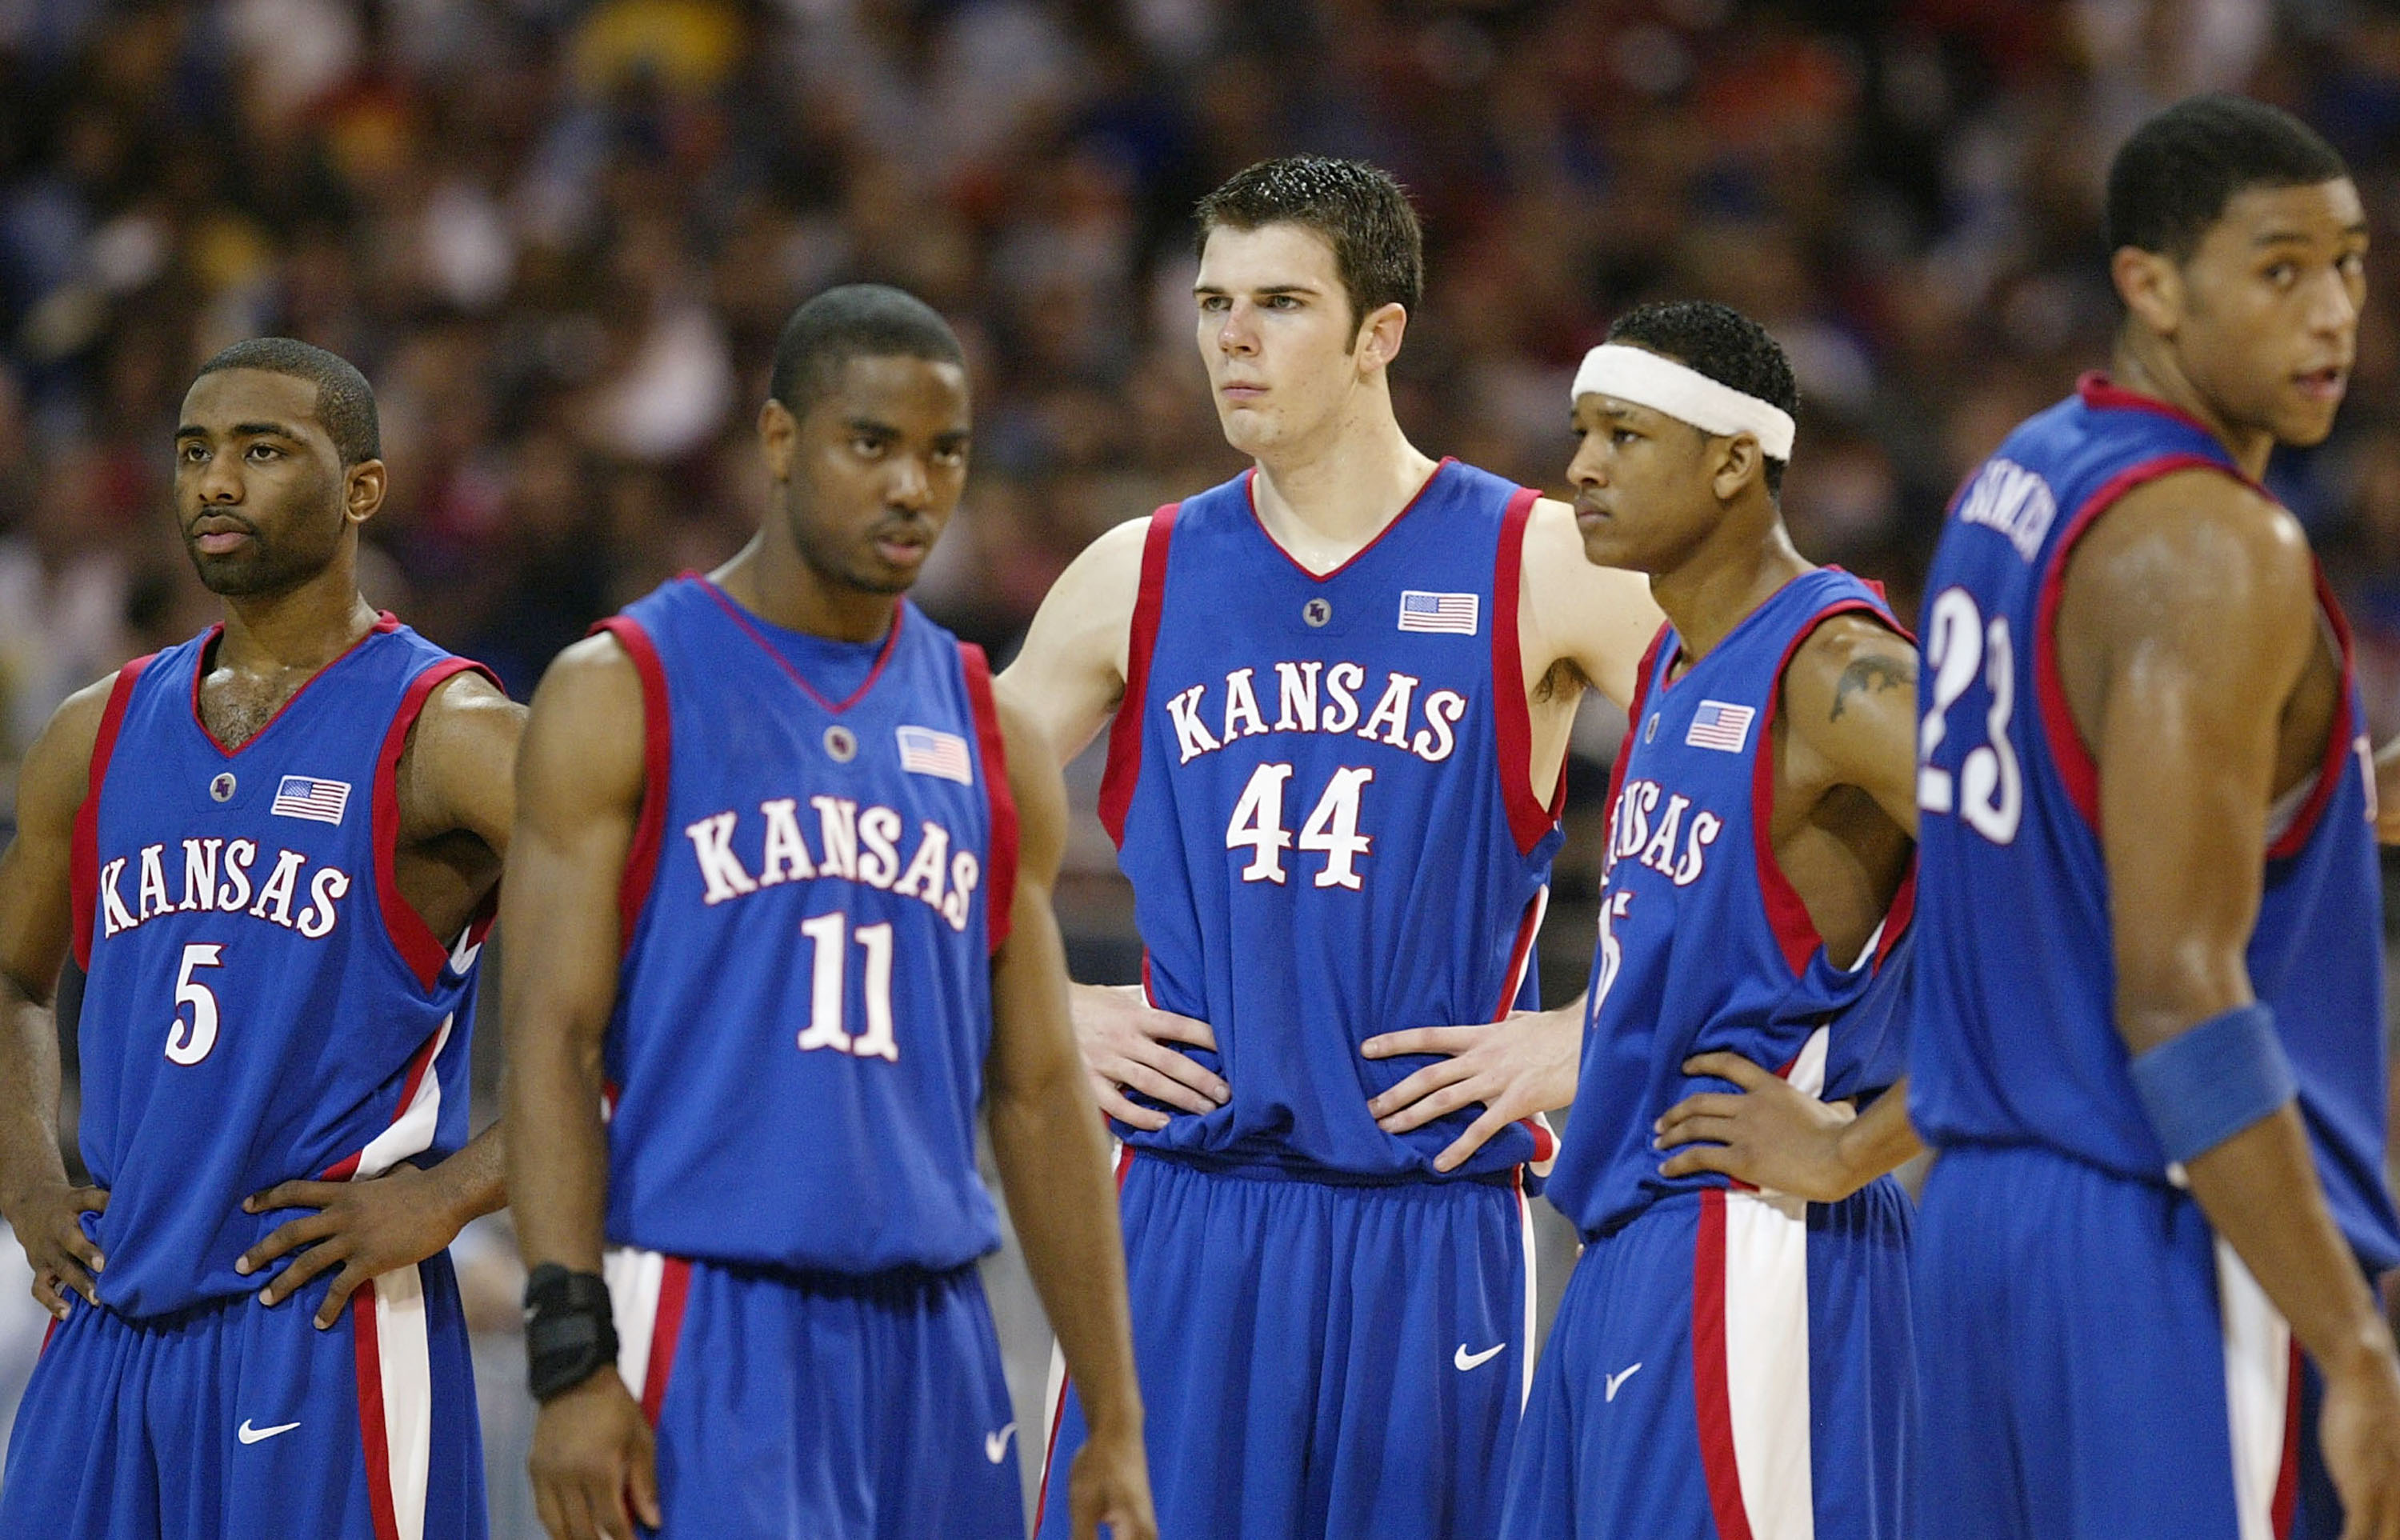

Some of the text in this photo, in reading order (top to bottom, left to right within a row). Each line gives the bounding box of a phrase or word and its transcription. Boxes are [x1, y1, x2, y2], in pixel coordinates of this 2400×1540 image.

[1166, 661, 1467, 766] KANSAS
[1918, 586, 2022, 845] 23
[100, 838, 351, 939] KANSAS
[685, 794, 981, 931] KANSAS
[1225, 762, 1375, 890] 44
[164, 943, 225, 1066] 5
[797, 911, 900, 1062] 11
